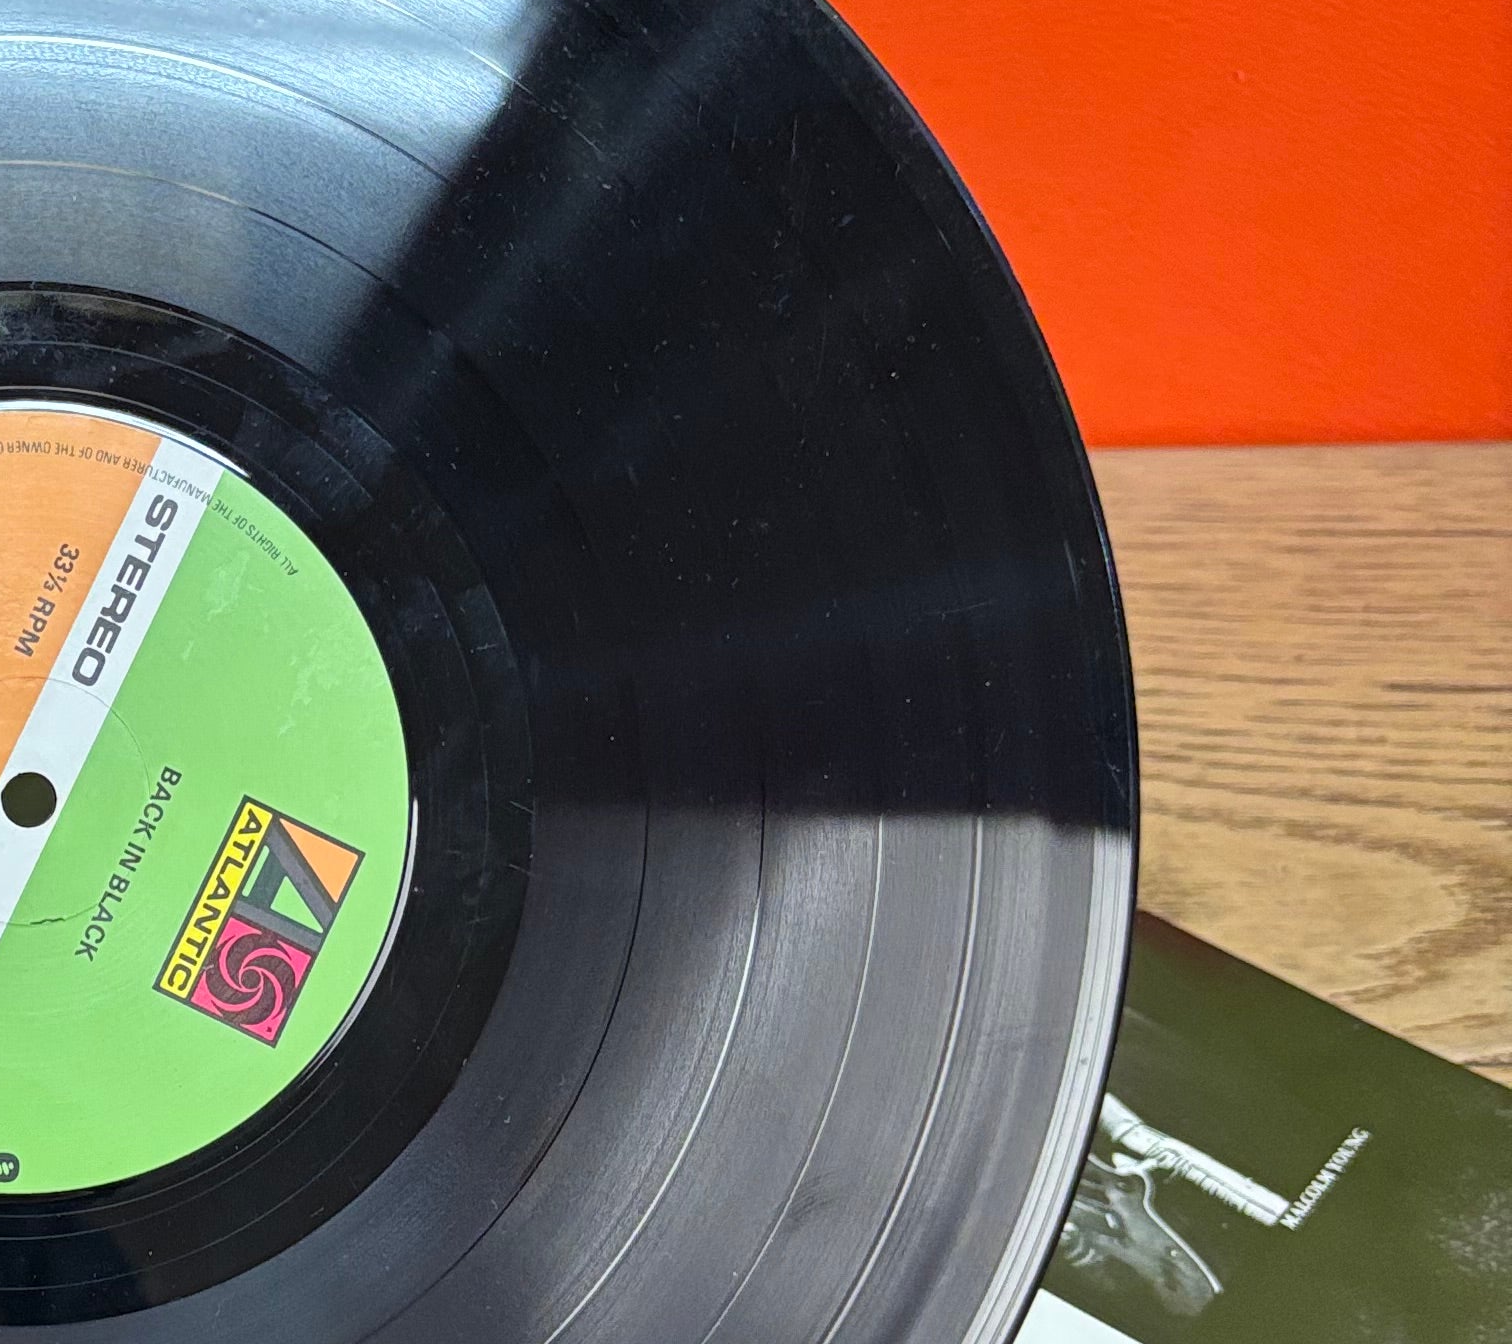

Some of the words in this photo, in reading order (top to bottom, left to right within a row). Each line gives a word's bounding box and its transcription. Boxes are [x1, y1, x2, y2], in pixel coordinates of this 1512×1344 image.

[6, 440, 51, 455] OWNER
[54, 442, 75, 457] THE
[78, 445, 93, 460] OF
[94, 448, 121, 466] AND
[121, 455, 214, 506] MANUFACTURER
[210, 497, 234, 520] THE
[231, 513, 248, 530] OF
[244, 523, 282, 560] RIGHTS
[278, 555, 299, 577] ALL
[69, 492, 180, 688] STEREO
[12, 595, 56, 658] RPM
[131, 764, 183, 841] BACK
[117, 840, 146, 873] IN
[73, 871, 131, 963] BLACK
[165, 807, 265, 992] ATLANTIC
[1328, 1126, 1371, 1174] YOUNG
